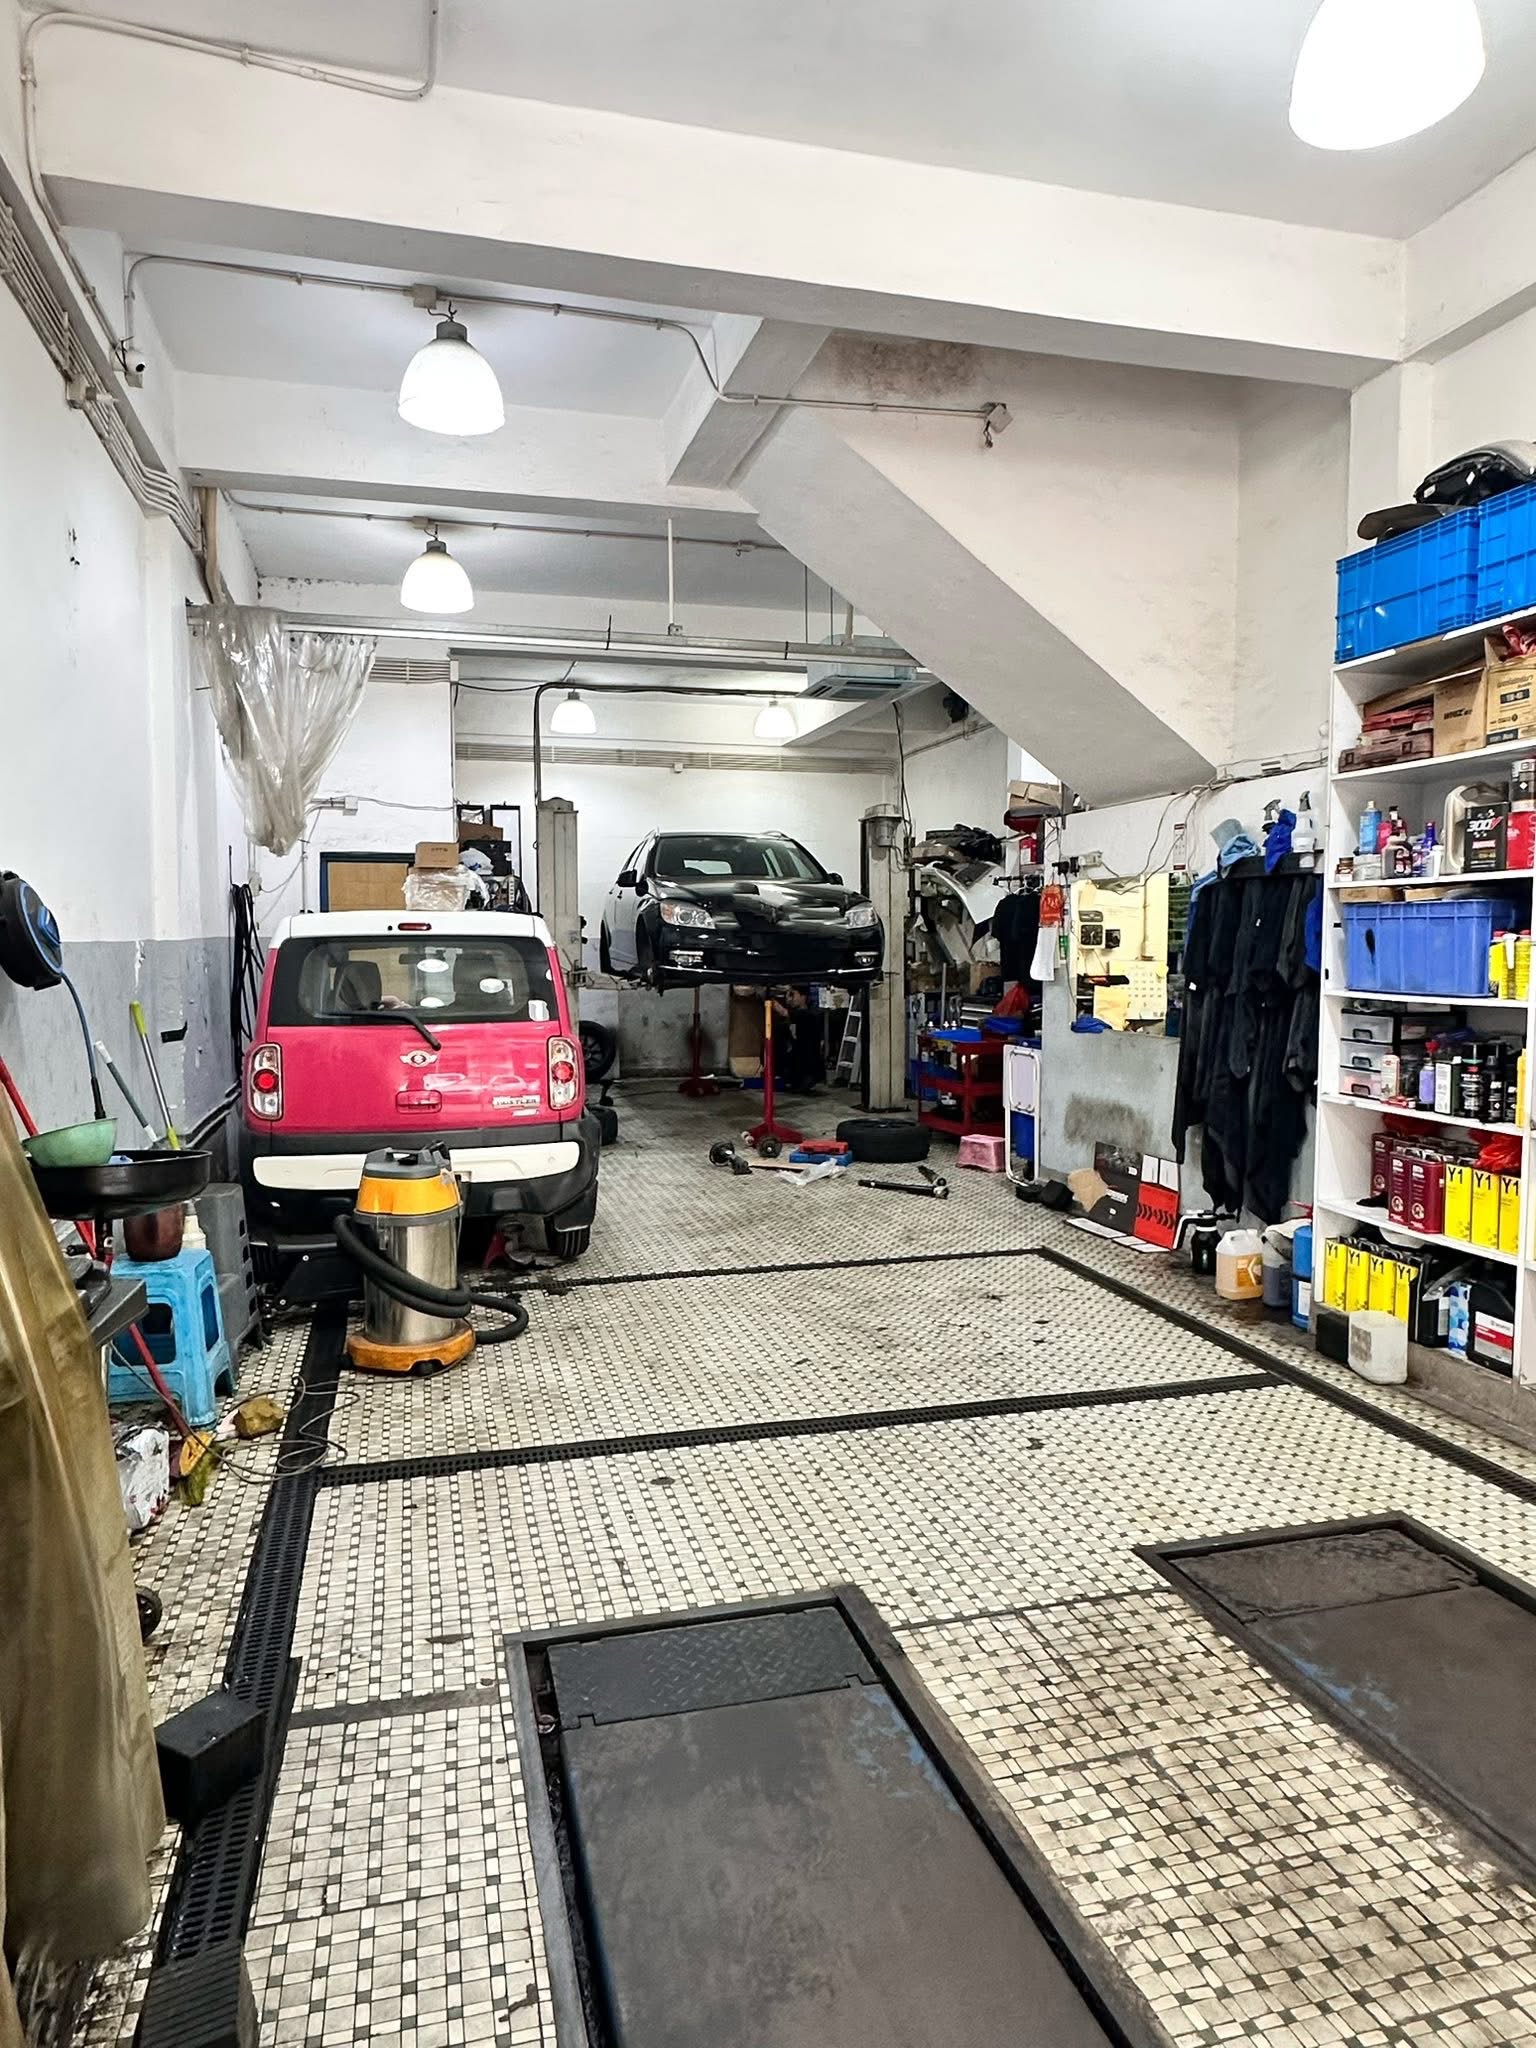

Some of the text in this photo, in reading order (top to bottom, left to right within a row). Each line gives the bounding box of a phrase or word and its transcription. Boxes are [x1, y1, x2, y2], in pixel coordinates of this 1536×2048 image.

[1467, 816, 1504, 833] 300V
[1448, 1166, 1463, 1184] Y1
[1474, 1172, 1491, 1190] Y1
[1501, 1177, 1519, 1197] Y1
[1327, 1243, 1338, 1258] Y1
[1349, 1250, 1360, 1266] Y1
[1371, 1257, 1384, 1274] Y1
[1397, 1264, 1411, 1282] Y1
